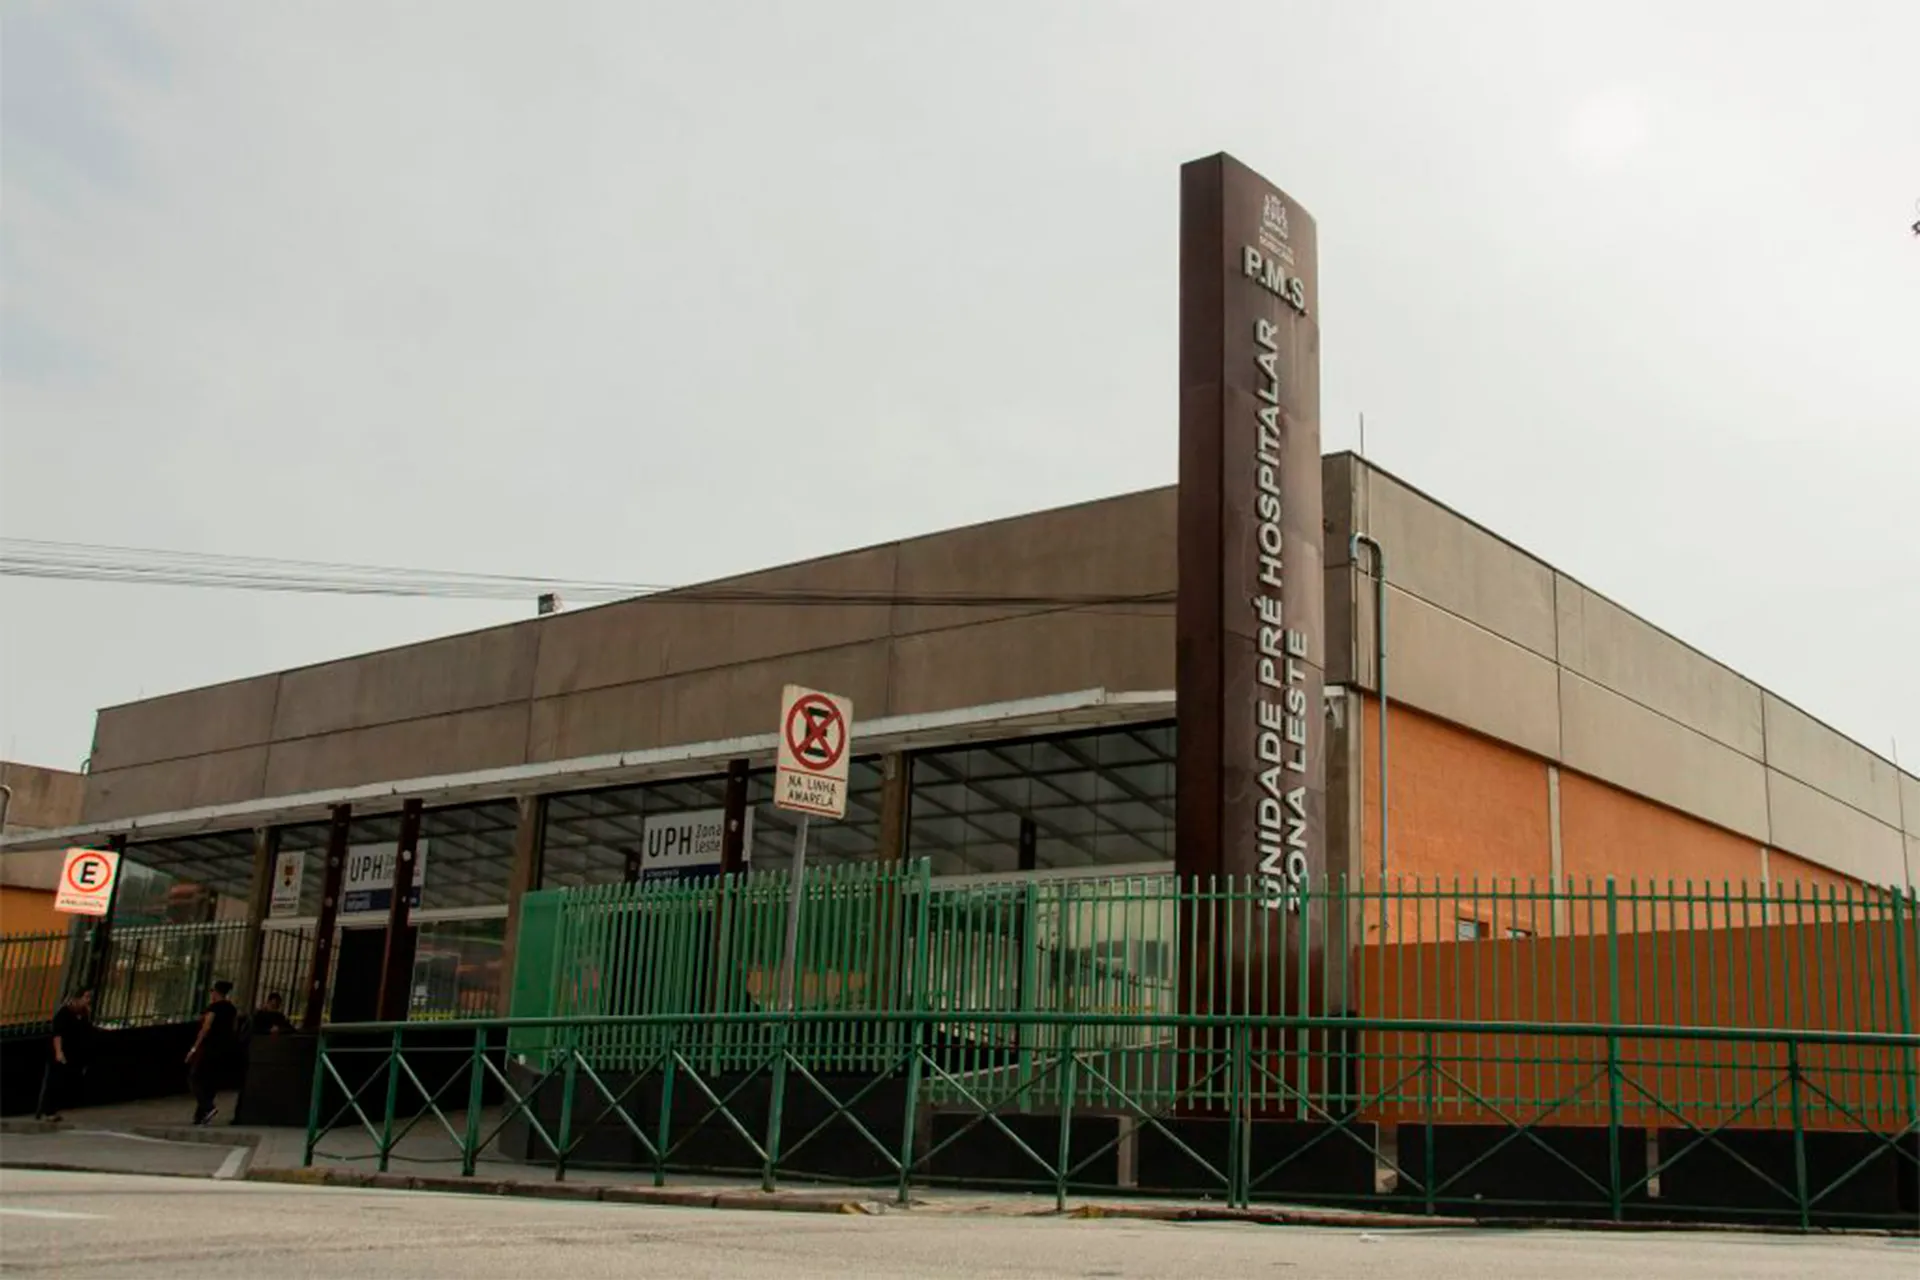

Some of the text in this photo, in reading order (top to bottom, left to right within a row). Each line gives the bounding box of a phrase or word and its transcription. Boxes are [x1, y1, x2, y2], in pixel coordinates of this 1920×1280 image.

[1253, 318, 1283, 910] UNIDADE PRÉ HOSPITALAR
[1286, 628, 1308, 773] LESTE
[787, 774, 837, 793] NA LINHA
[787, 789, 834, 808] AMARELA
[648, 825, 693, 858] UPH
[80, 861, 99, 884] E
[350, 854, 384, 882] UPH
